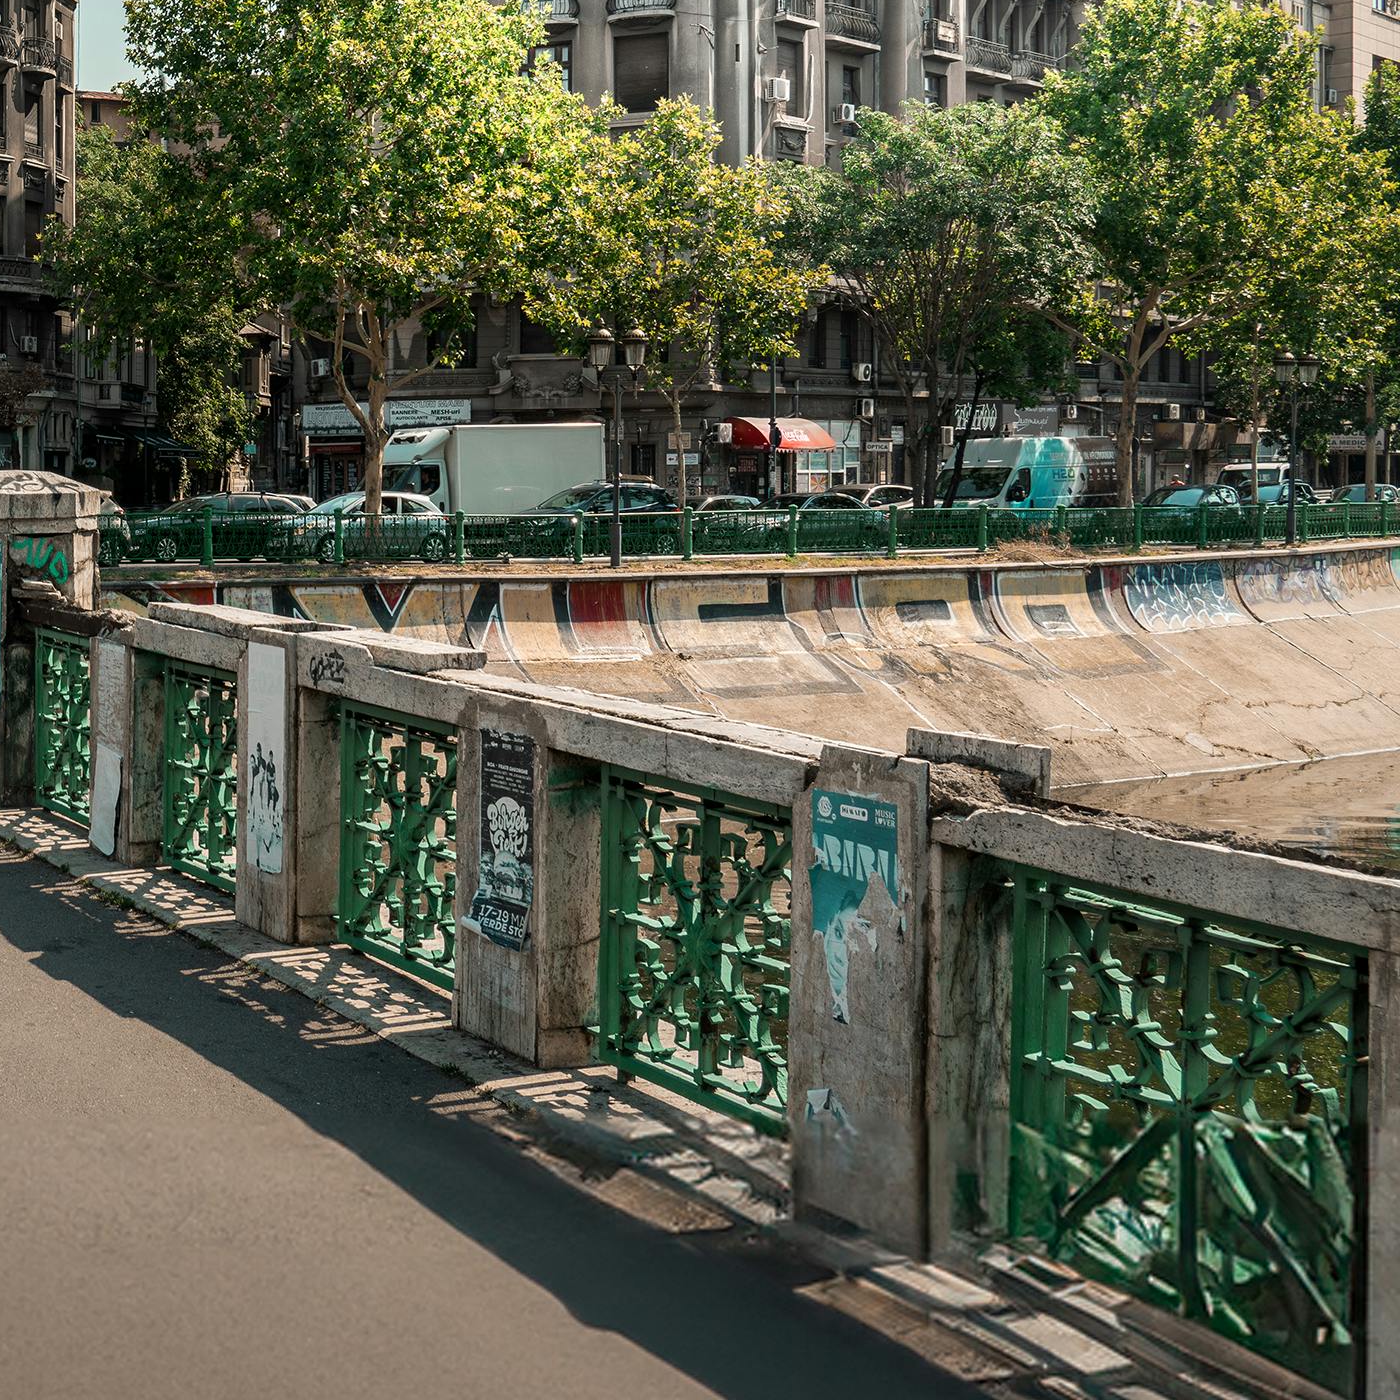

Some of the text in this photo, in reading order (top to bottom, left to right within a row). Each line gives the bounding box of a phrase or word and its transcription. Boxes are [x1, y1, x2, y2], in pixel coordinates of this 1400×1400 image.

[875, 808, 896, 820] MUSIC
[479, 904, 510, 922] 17-19
[477, 915, 508, 934] VERDE
